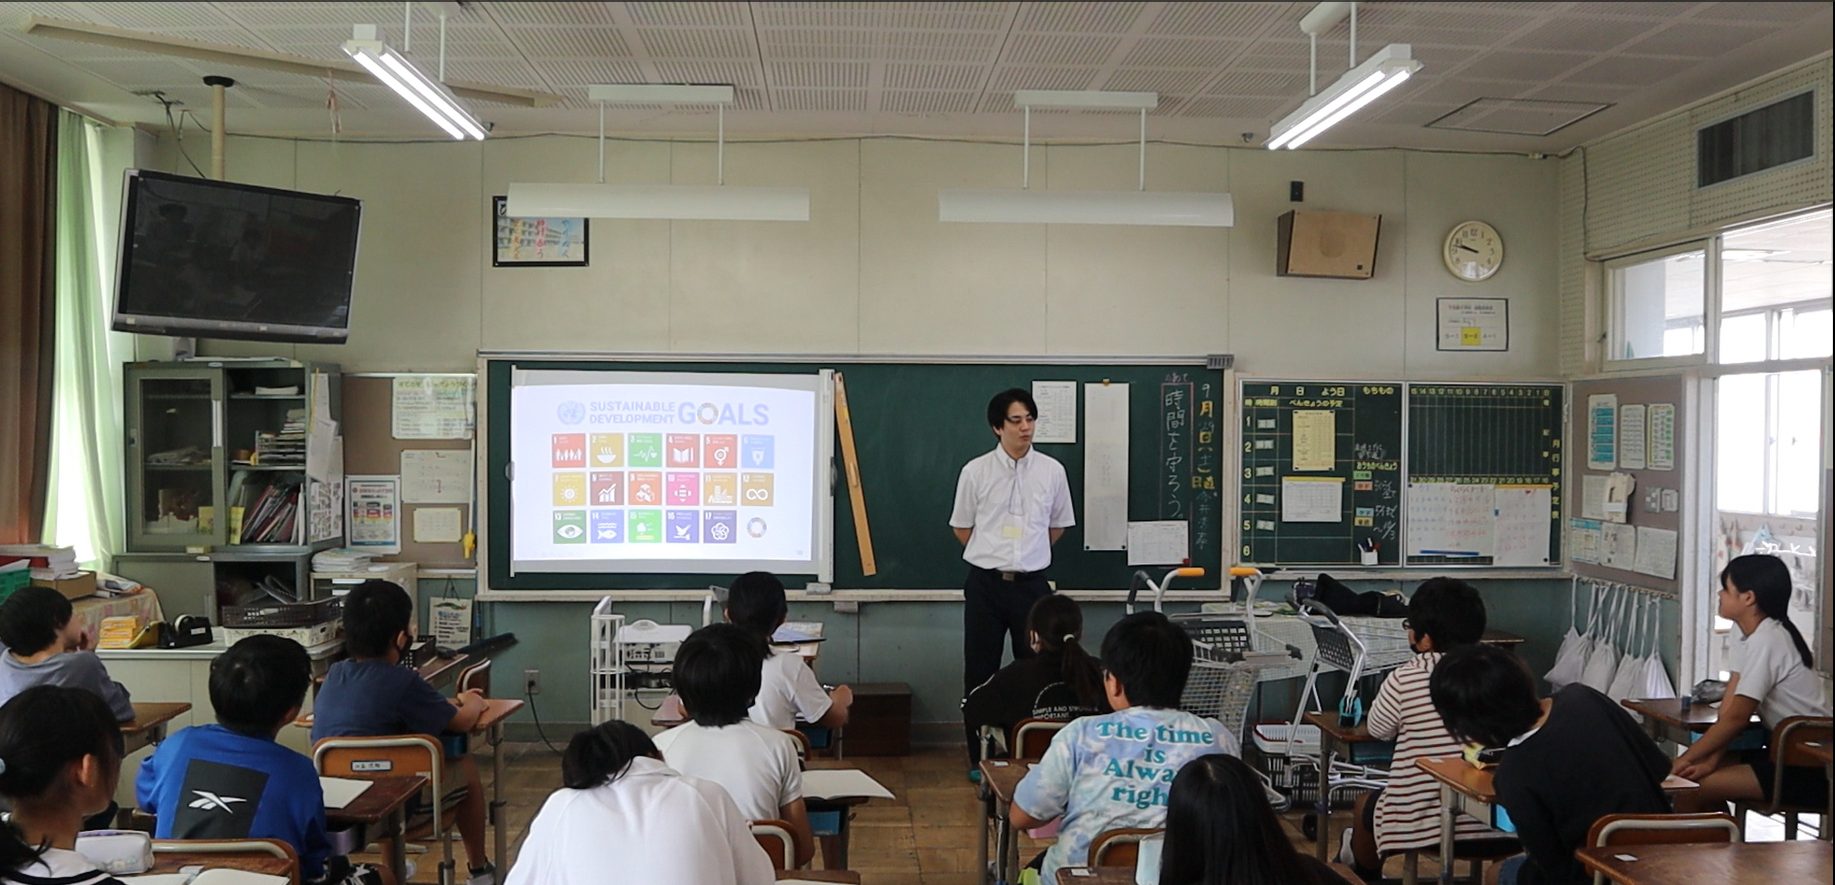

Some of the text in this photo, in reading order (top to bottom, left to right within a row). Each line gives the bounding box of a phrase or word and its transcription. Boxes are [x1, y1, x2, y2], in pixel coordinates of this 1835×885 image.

[1270, 386, 1346, 397] 月 日 よう日
[590, 401, 675, 413] SUSTAINABLE
[589, 402, 770, 425] DEVELOPMENT GOALS
[1246, 416, 1251, 428] 1
[1244, 441, 1252, 453] 2
[1244, 467, 1252, 479] 3
[1244, 494, 1251, 504] 4
[1243, 520, 1251, 531] 5
[1243, 545, 1250, 556] 6
[1096, 721, 1214, 744] The time
[1143, 744, 1166, 763] is
[1103, 758, 1174, 783] Alwa
[1112, 786, 1168, 810] righ
